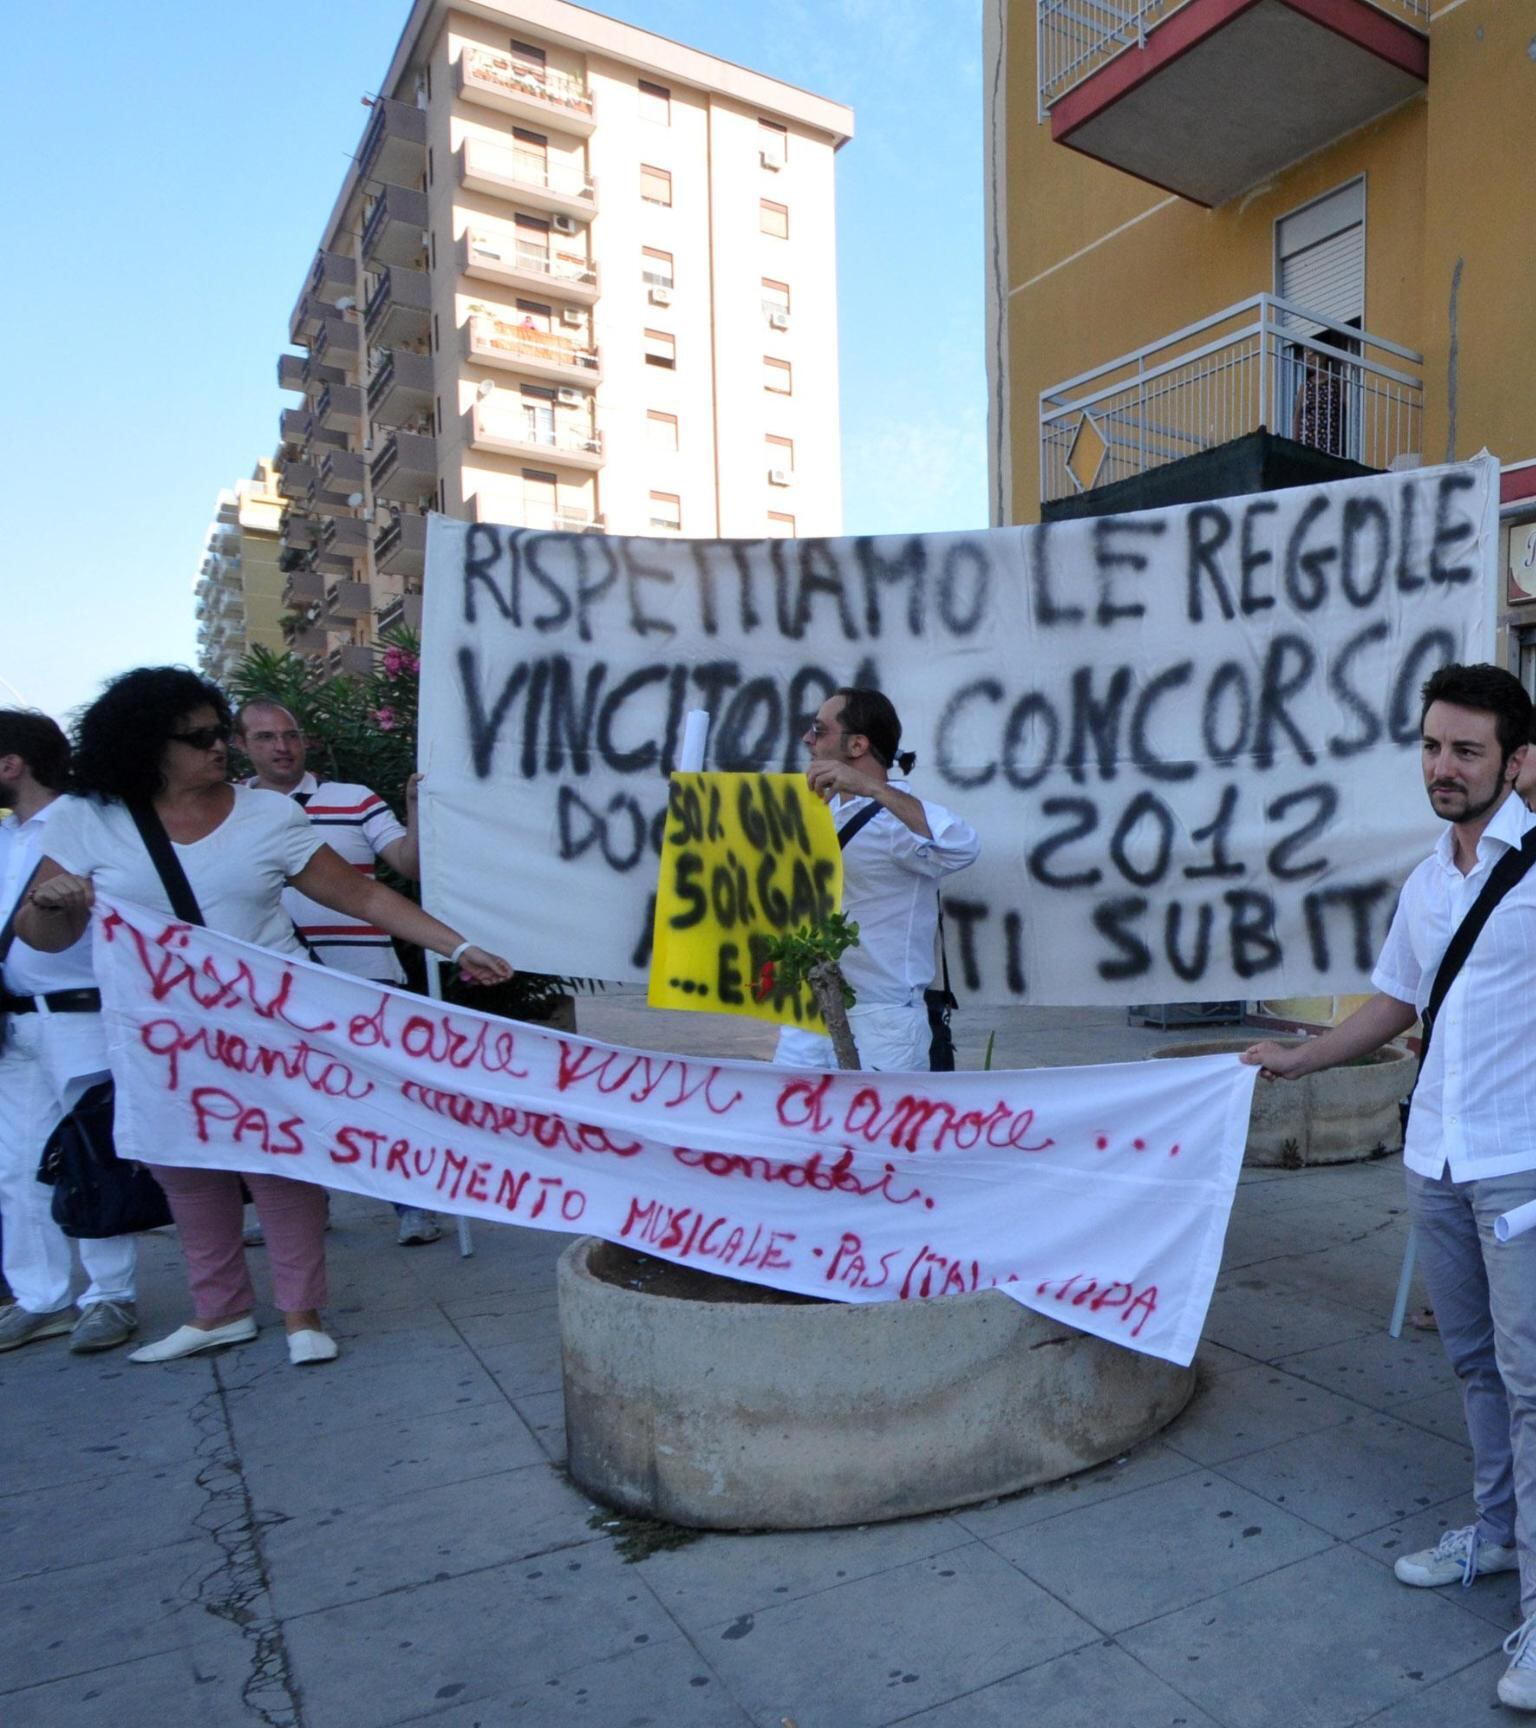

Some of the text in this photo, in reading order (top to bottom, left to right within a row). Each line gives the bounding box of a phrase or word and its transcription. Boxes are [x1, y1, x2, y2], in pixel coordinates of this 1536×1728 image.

[463, 474, 1476, 642] RISPETTIAMO LE REGOLE
[1027, 782, 1340, 889] 2012
[1093, 880, 1399, 982] SUBIT
[191, 1087, 304, 1155] PAS
[331, 1126, 587, 1221] STRUMENTO
[622, 1196, 795, 1270] MUSICALE
